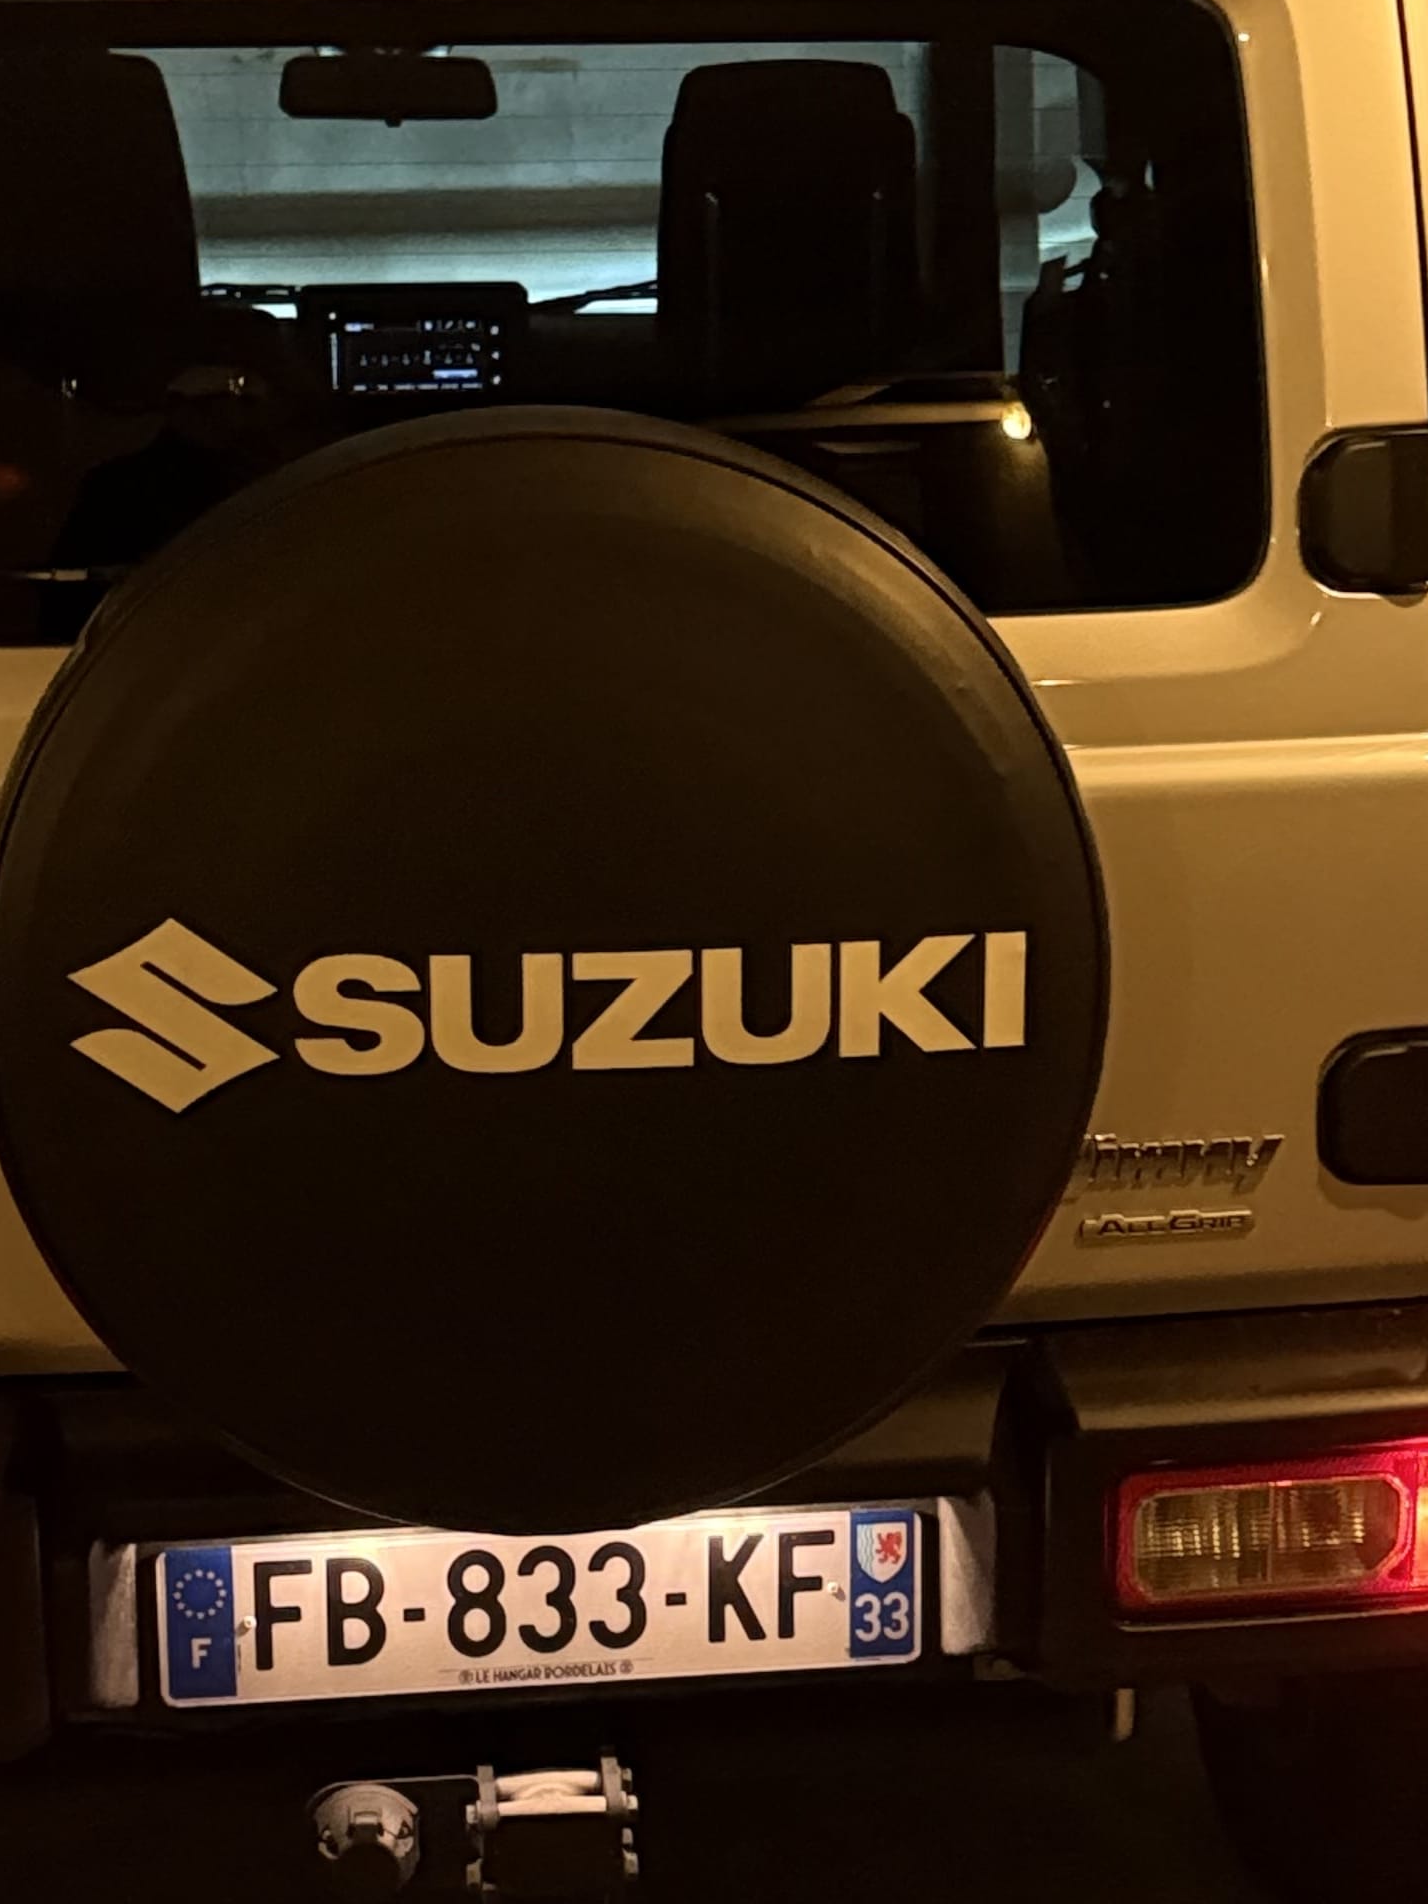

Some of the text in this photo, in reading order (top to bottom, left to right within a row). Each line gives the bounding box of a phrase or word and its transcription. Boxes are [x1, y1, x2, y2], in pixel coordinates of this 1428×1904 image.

[292, 929, 1027, 1075] SUZUKI
[1078, 1132, 1285, 1193] imny
[252, 1530, 835, 1671] FB-833-KF
[854, 1591, 911, 1643] 33
[190, 1637, 213, 1670] F
[476, 1670, 489, 1683] LE
[493, 1667, 541, 1683] HANGAR
